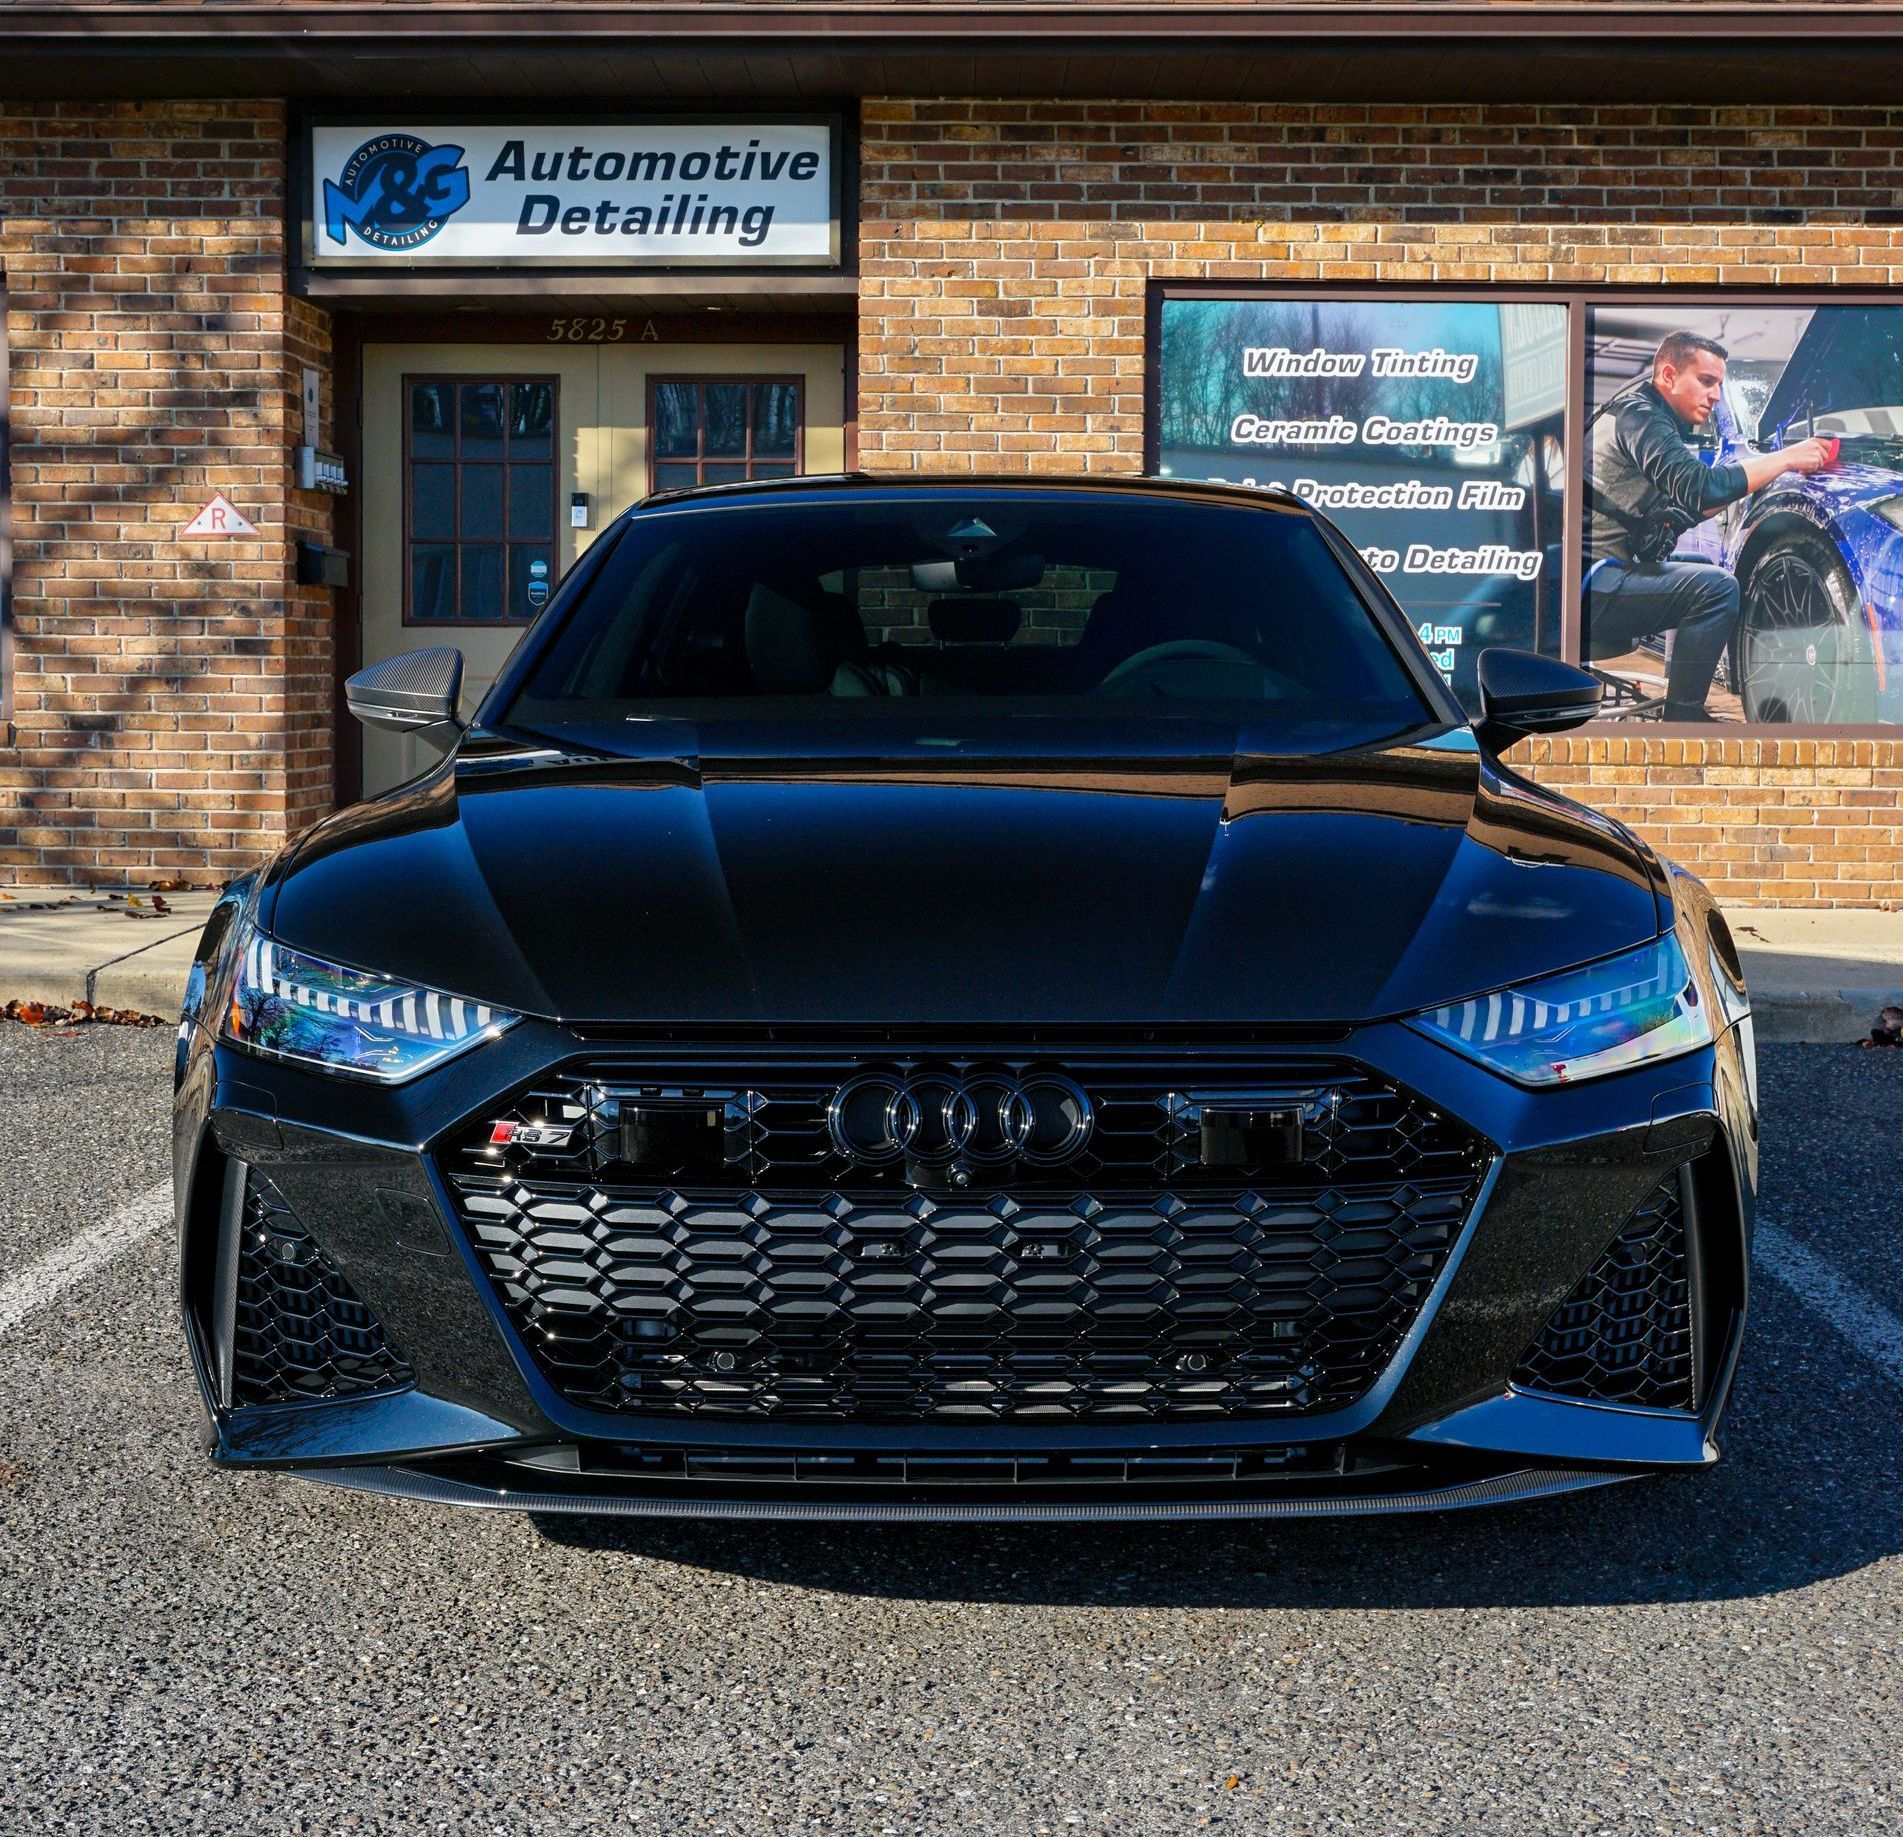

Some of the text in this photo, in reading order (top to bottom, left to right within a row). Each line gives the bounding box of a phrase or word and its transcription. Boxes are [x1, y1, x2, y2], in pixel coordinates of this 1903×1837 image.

[345, 138, 424, 187] AUTOMOTIVE
[485, 139, 819, 182] Automotive
[323, 144, 470, 246] M&G
[363, 219, 438, 246] DETAILING
[516, 193, 775, 246] Detailing
[546, 318, 659, 341] 5825 A
[1243, 349, 1366, 377] Window
[1370, 349, 1478, 383] Tinting
[1231, 413, 1498, 449] Ceramic Coatings
[1292, 479, 1452, 510] Protection
[1457, 480, 1526, 510] Film
[211, 507, 227, 530] R
[1358, 546, 1542, 581] to Detailing
[1434, 626, 1462, 644] PM
